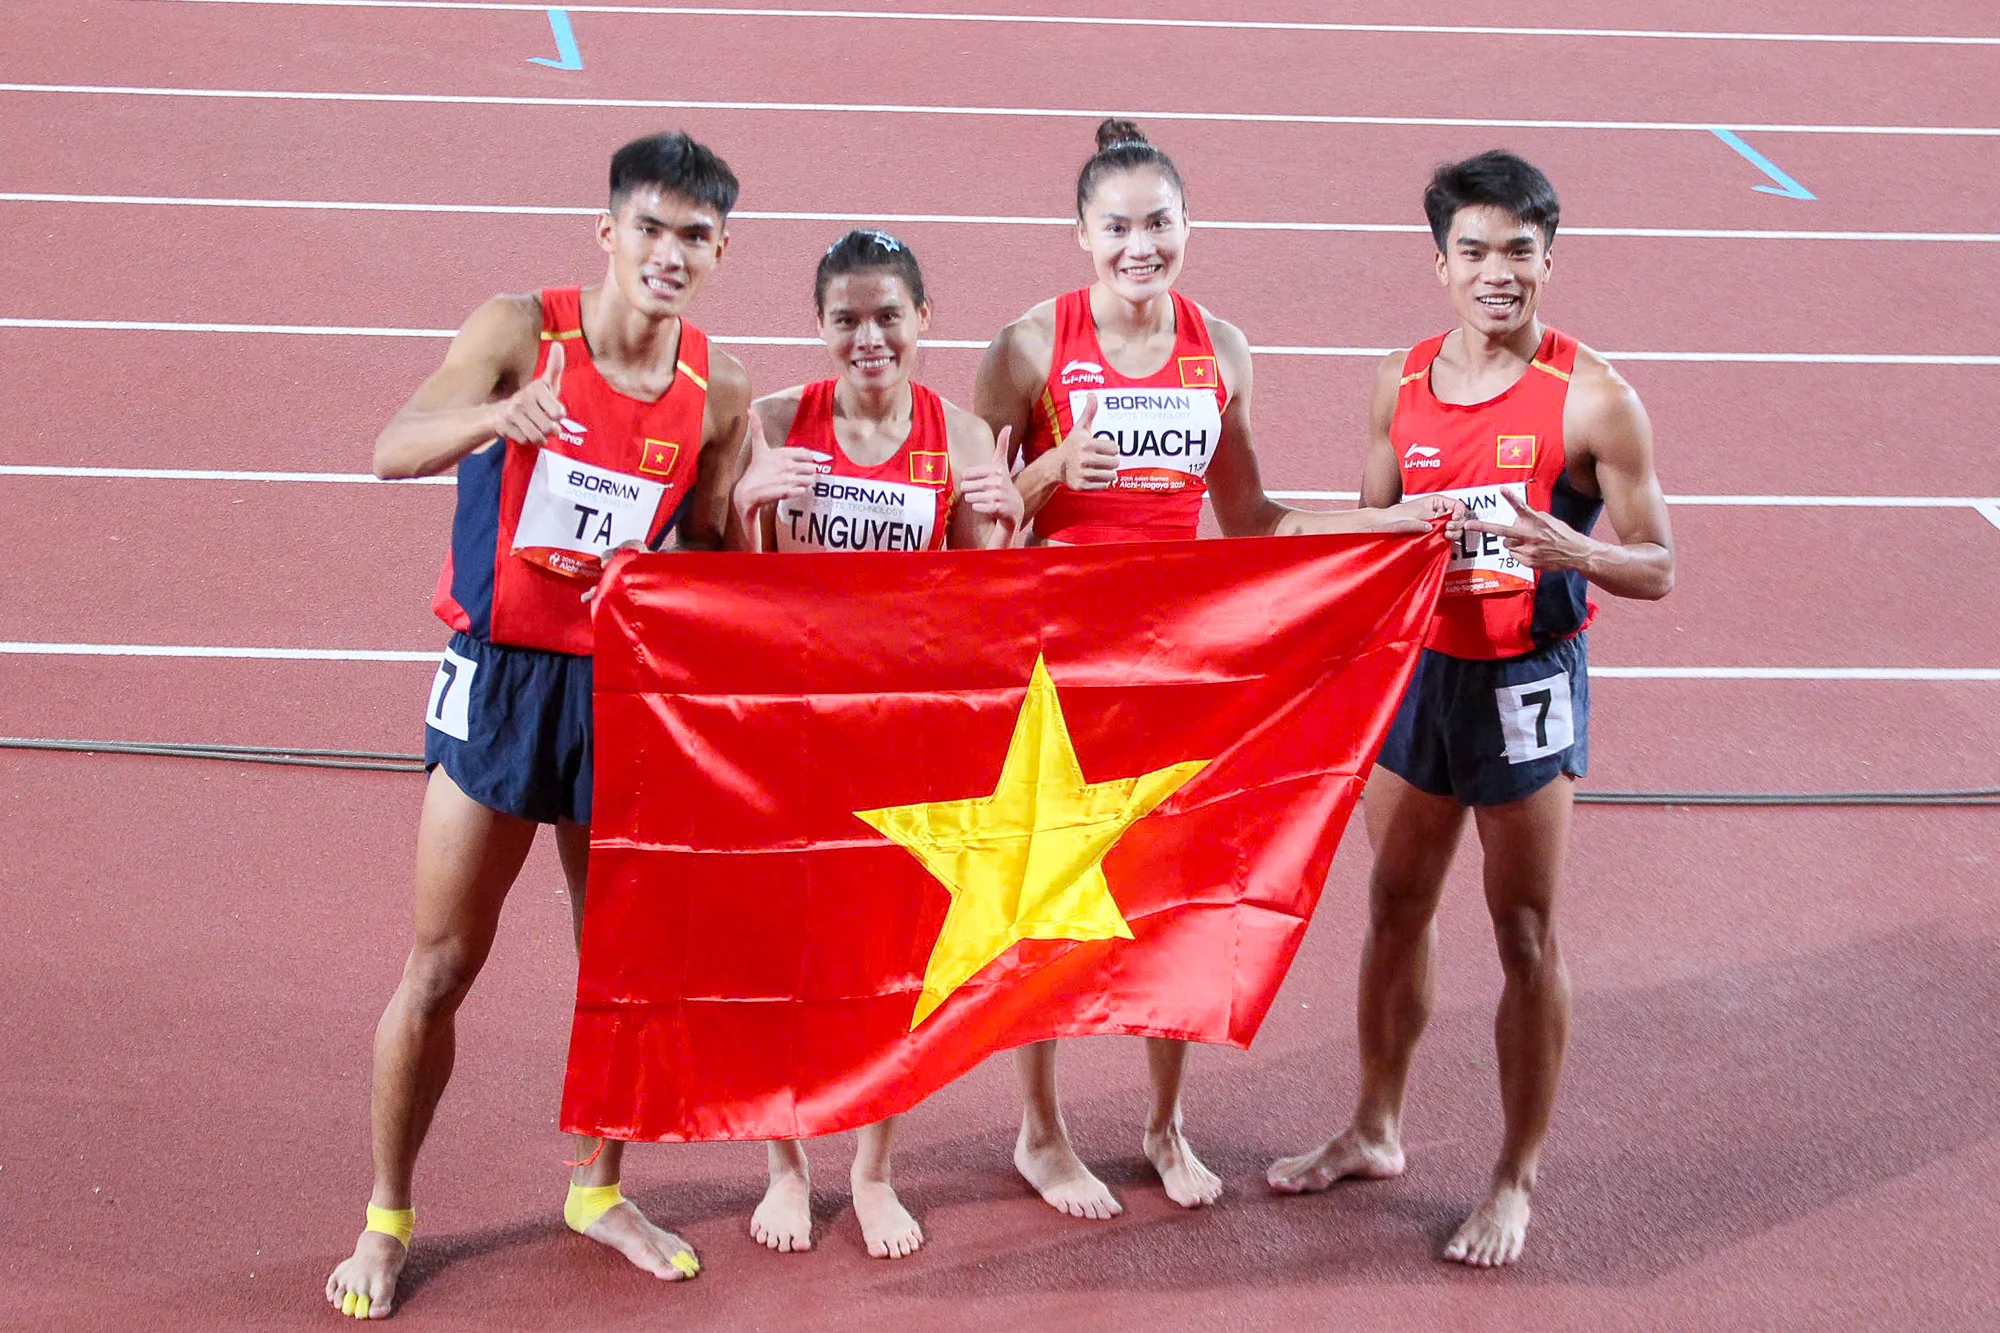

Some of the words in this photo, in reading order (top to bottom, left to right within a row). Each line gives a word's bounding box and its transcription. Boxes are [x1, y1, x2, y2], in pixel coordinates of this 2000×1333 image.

[1103, 396, 1190, 409] BORNAN
[1404, 459, 1441, 468] LI-NING
[567, 470, 640, 501] BORNAN
[813, 482, 905, 506] BORNAN
[1459, 494, 1497, 511] NAN
[574, 504, 613, 546] TA
[788, 509, 923, 551] T.NGUYEN
[435, 658, 458, 721] 7
[1520, 688, 1552, 748] 7
